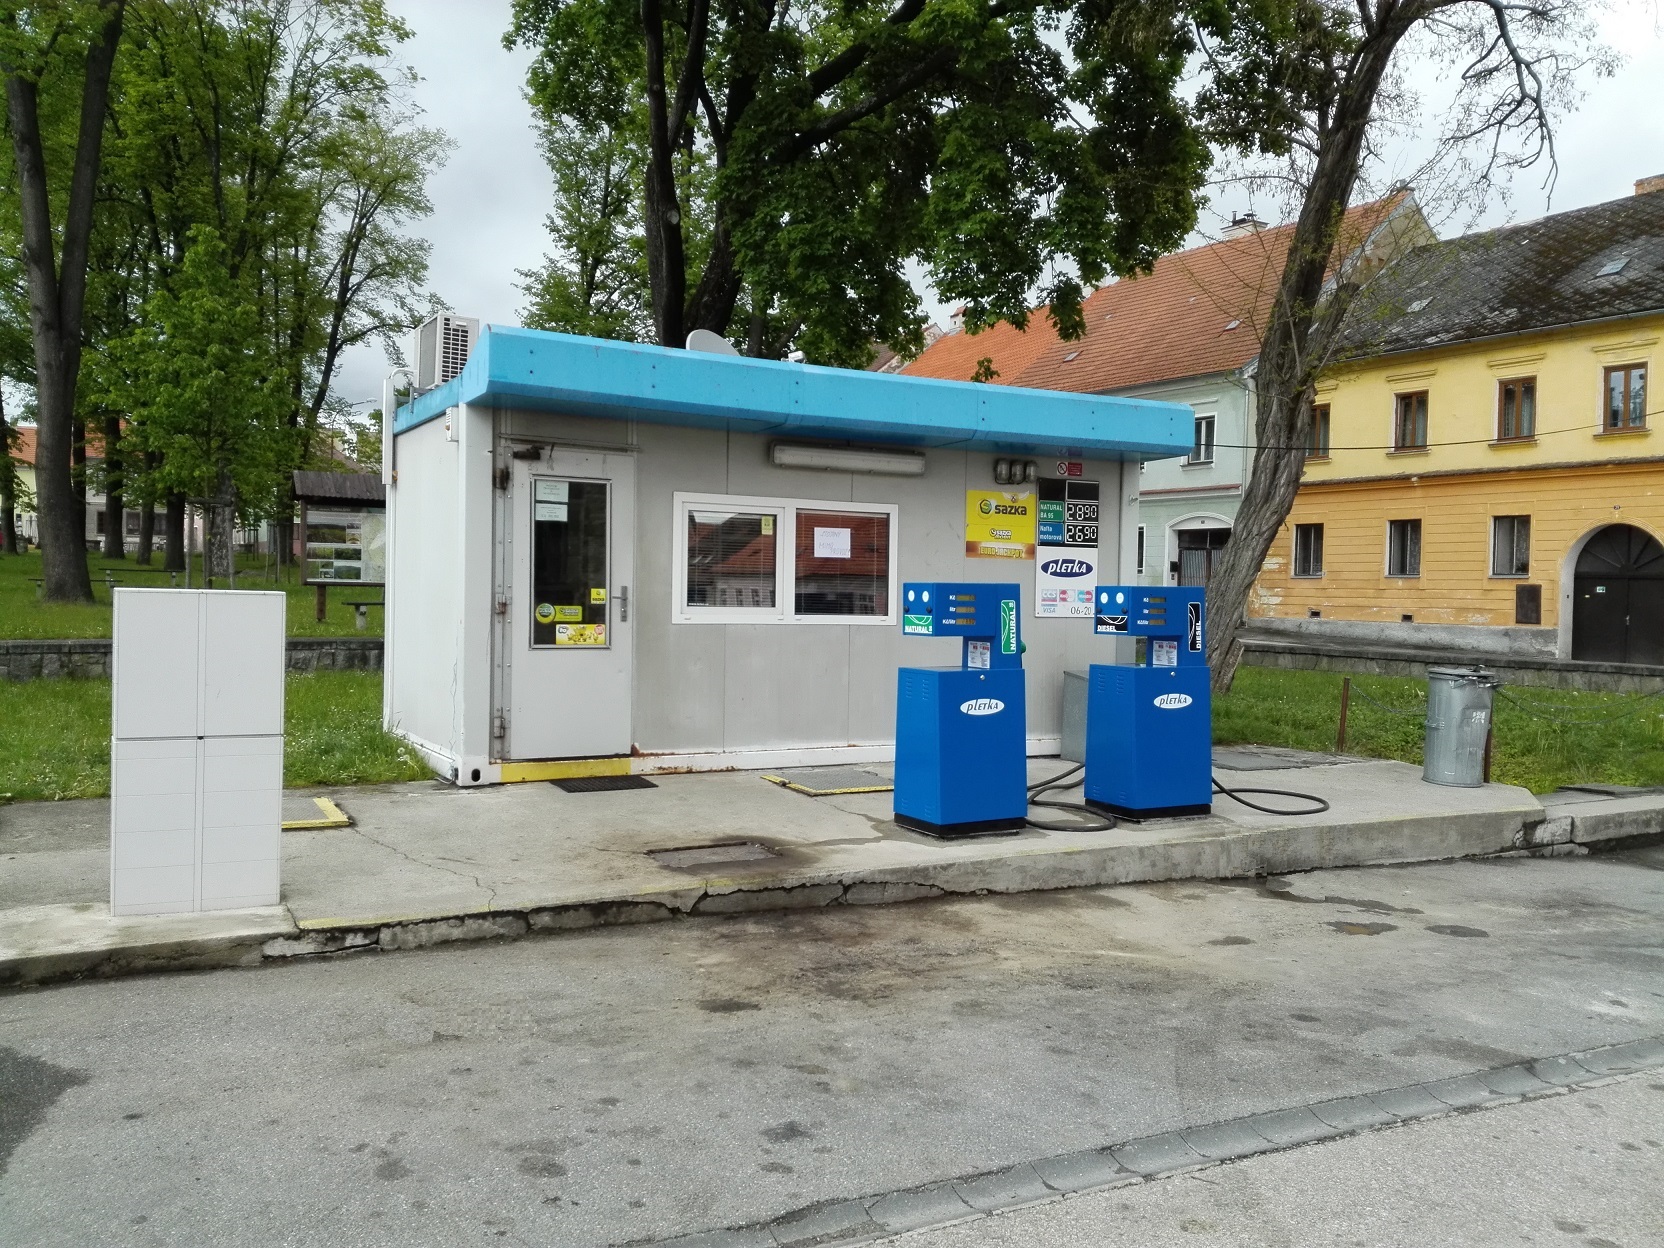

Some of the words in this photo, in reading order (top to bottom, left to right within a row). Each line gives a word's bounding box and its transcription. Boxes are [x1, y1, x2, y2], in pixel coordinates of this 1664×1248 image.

[1040, 503, 1063, 511] NATURAL
[1039, 533, 1062, 541] motorová
[1042, 590, 1057, 598] CCS
[1070, 606, 1092, 615] 06-20
[904, 625, 928, 633] NATURAL
[1097, 624, 1117, 632] DIESEL
